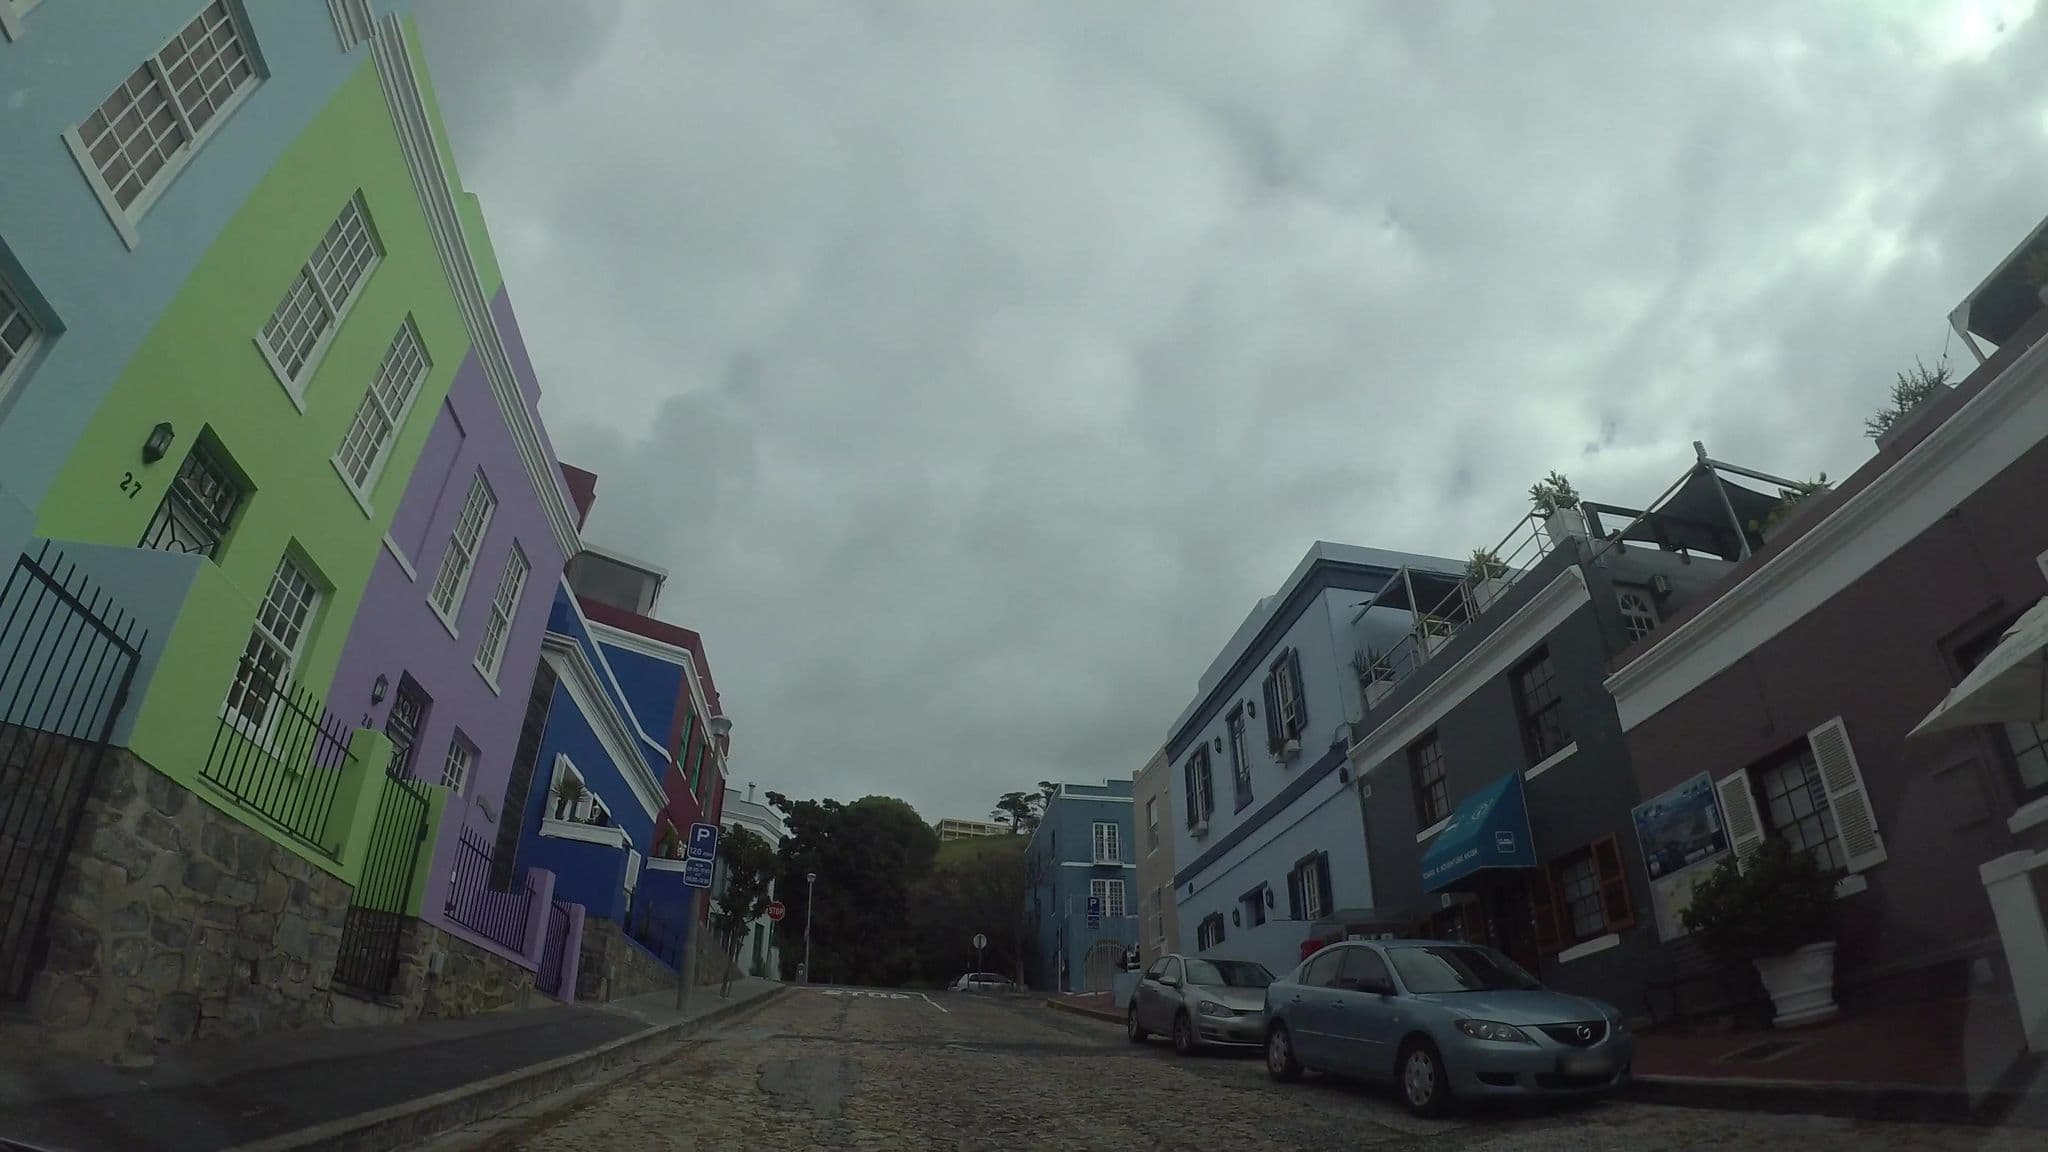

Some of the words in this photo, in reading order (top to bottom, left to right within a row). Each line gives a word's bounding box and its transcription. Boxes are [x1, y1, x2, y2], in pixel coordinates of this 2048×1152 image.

[120, 472, 142, 499] 27
[696, 828, 710, 842] P
[689, 847, 702, 856] 120
[769, 906, 783, 916] STOP
